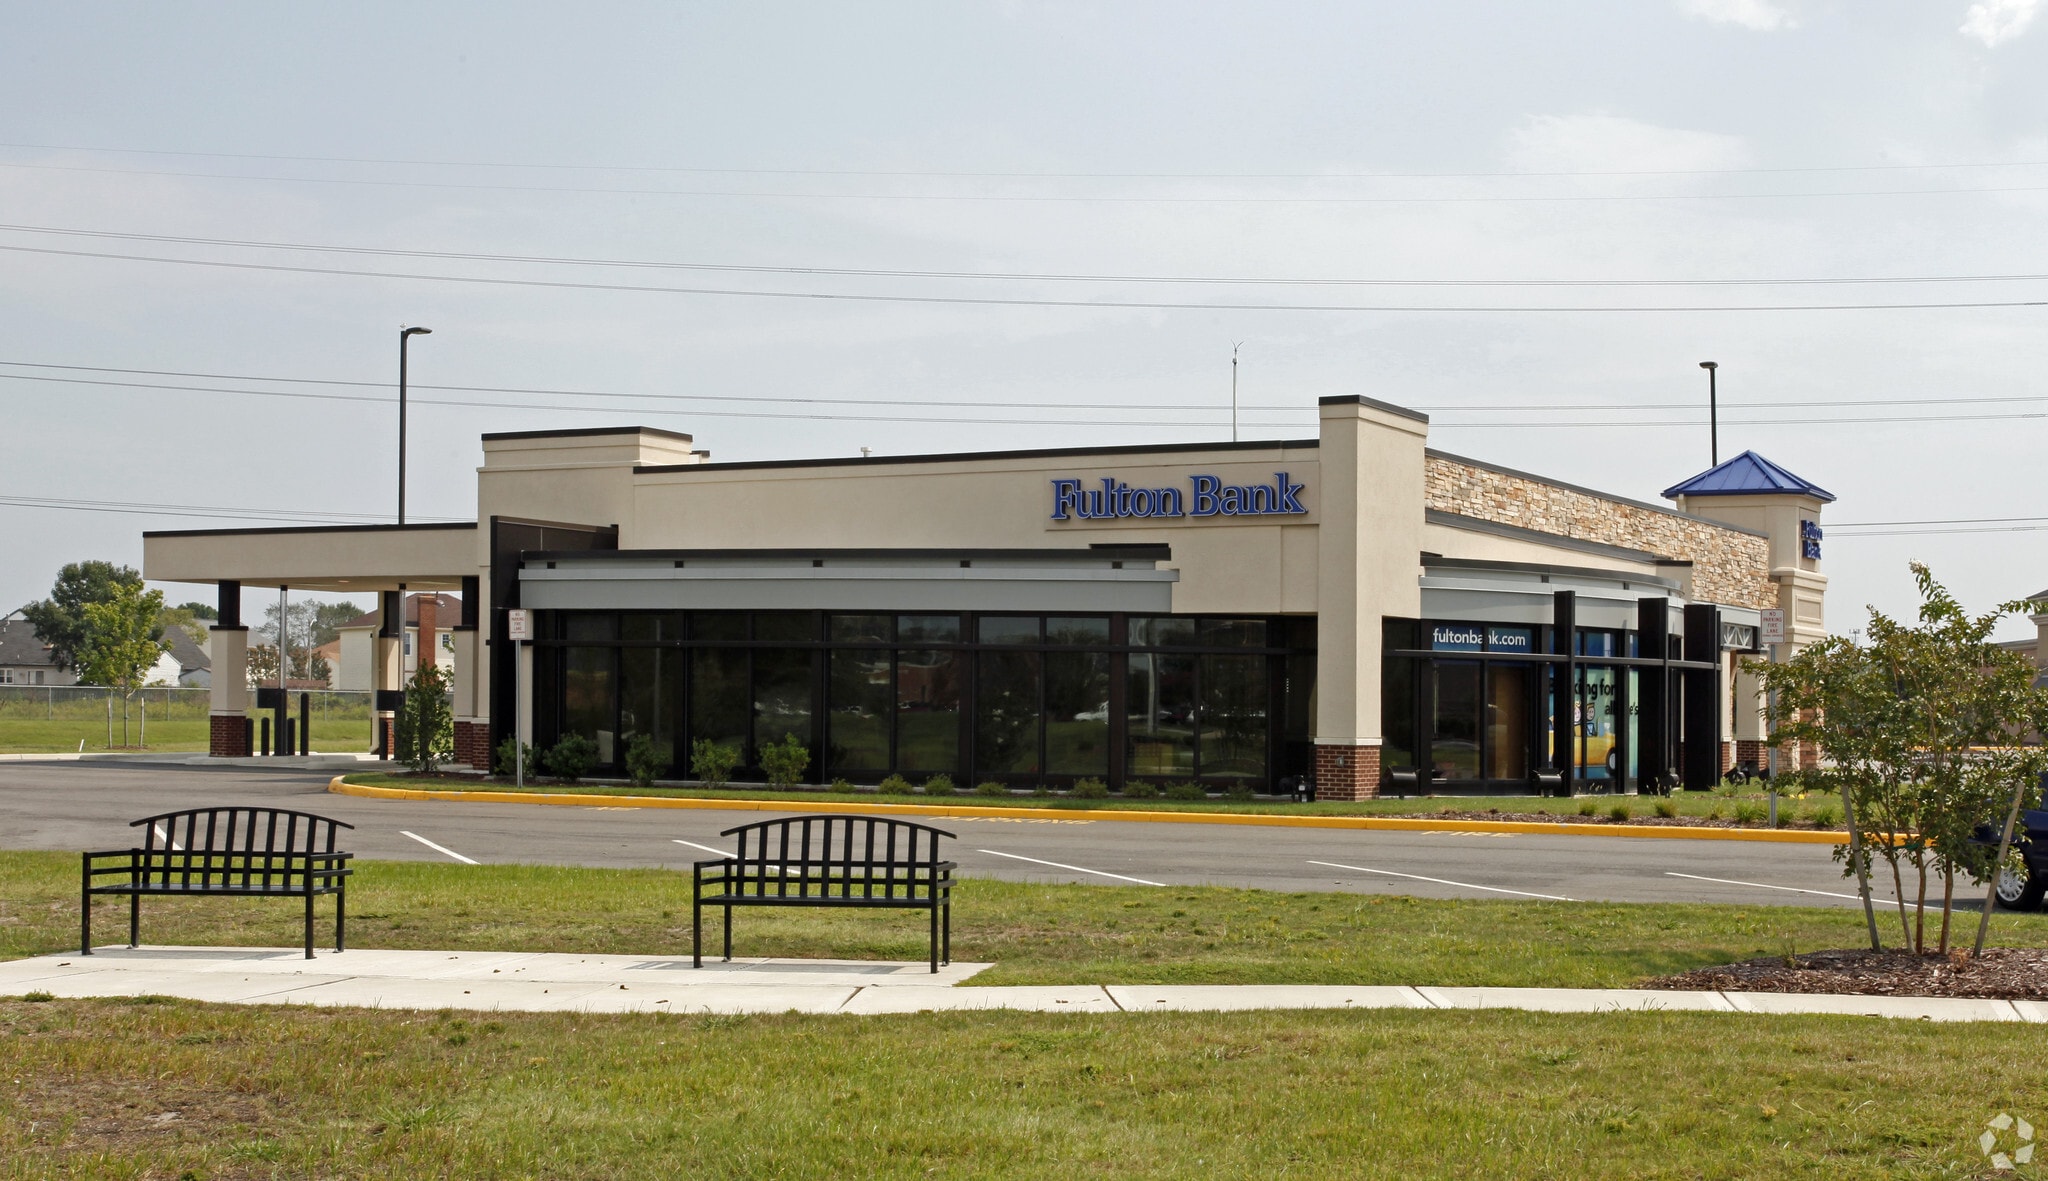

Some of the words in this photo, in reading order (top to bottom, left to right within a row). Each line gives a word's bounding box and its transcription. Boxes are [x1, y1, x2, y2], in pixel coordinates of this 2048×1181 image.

[1051, 477, 1185, 520] Fulton
[1189, 471, 1308, 517] Bank
[1600, 678, 1617, 696] for
